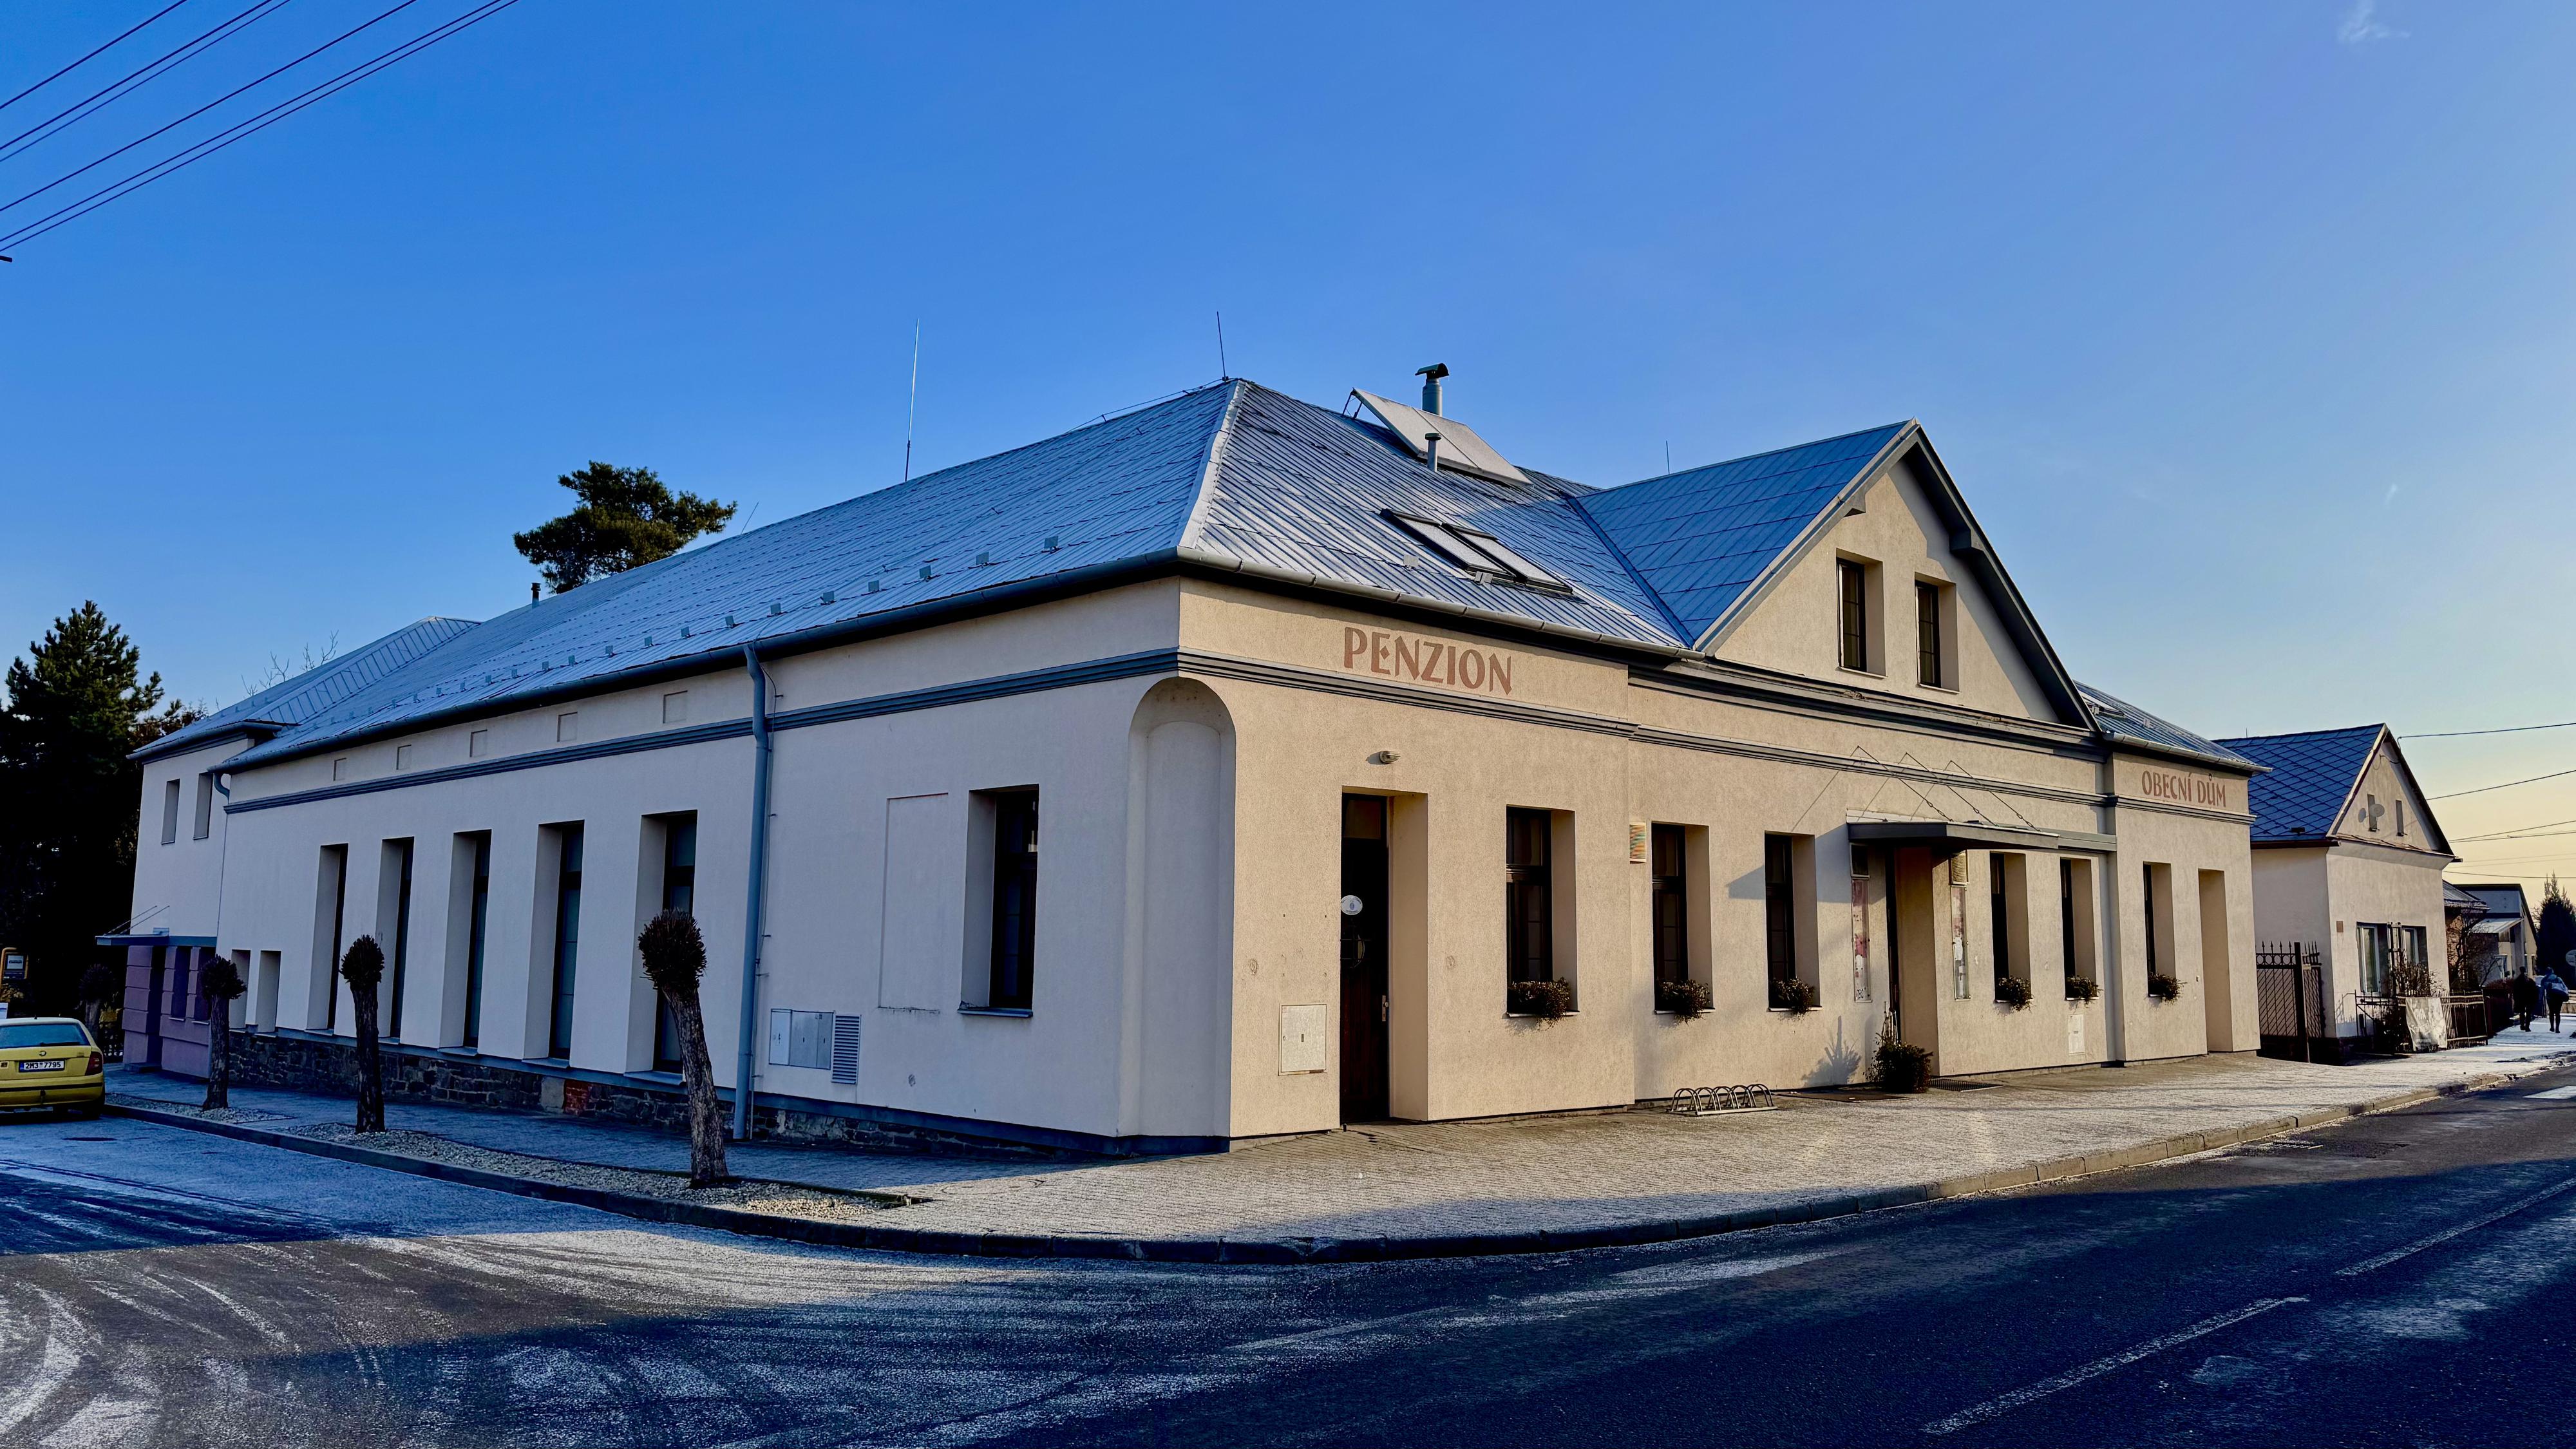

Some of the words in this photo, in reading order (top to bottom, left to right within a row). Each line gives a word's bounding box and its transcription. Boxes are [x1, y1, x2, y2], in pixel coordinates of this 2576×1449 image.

[1344, 627, 1512, 695] PENZION
[2141, 770, 2192, 802] OBECNÍ
[2197, 773, 2226, 807] DŮM
